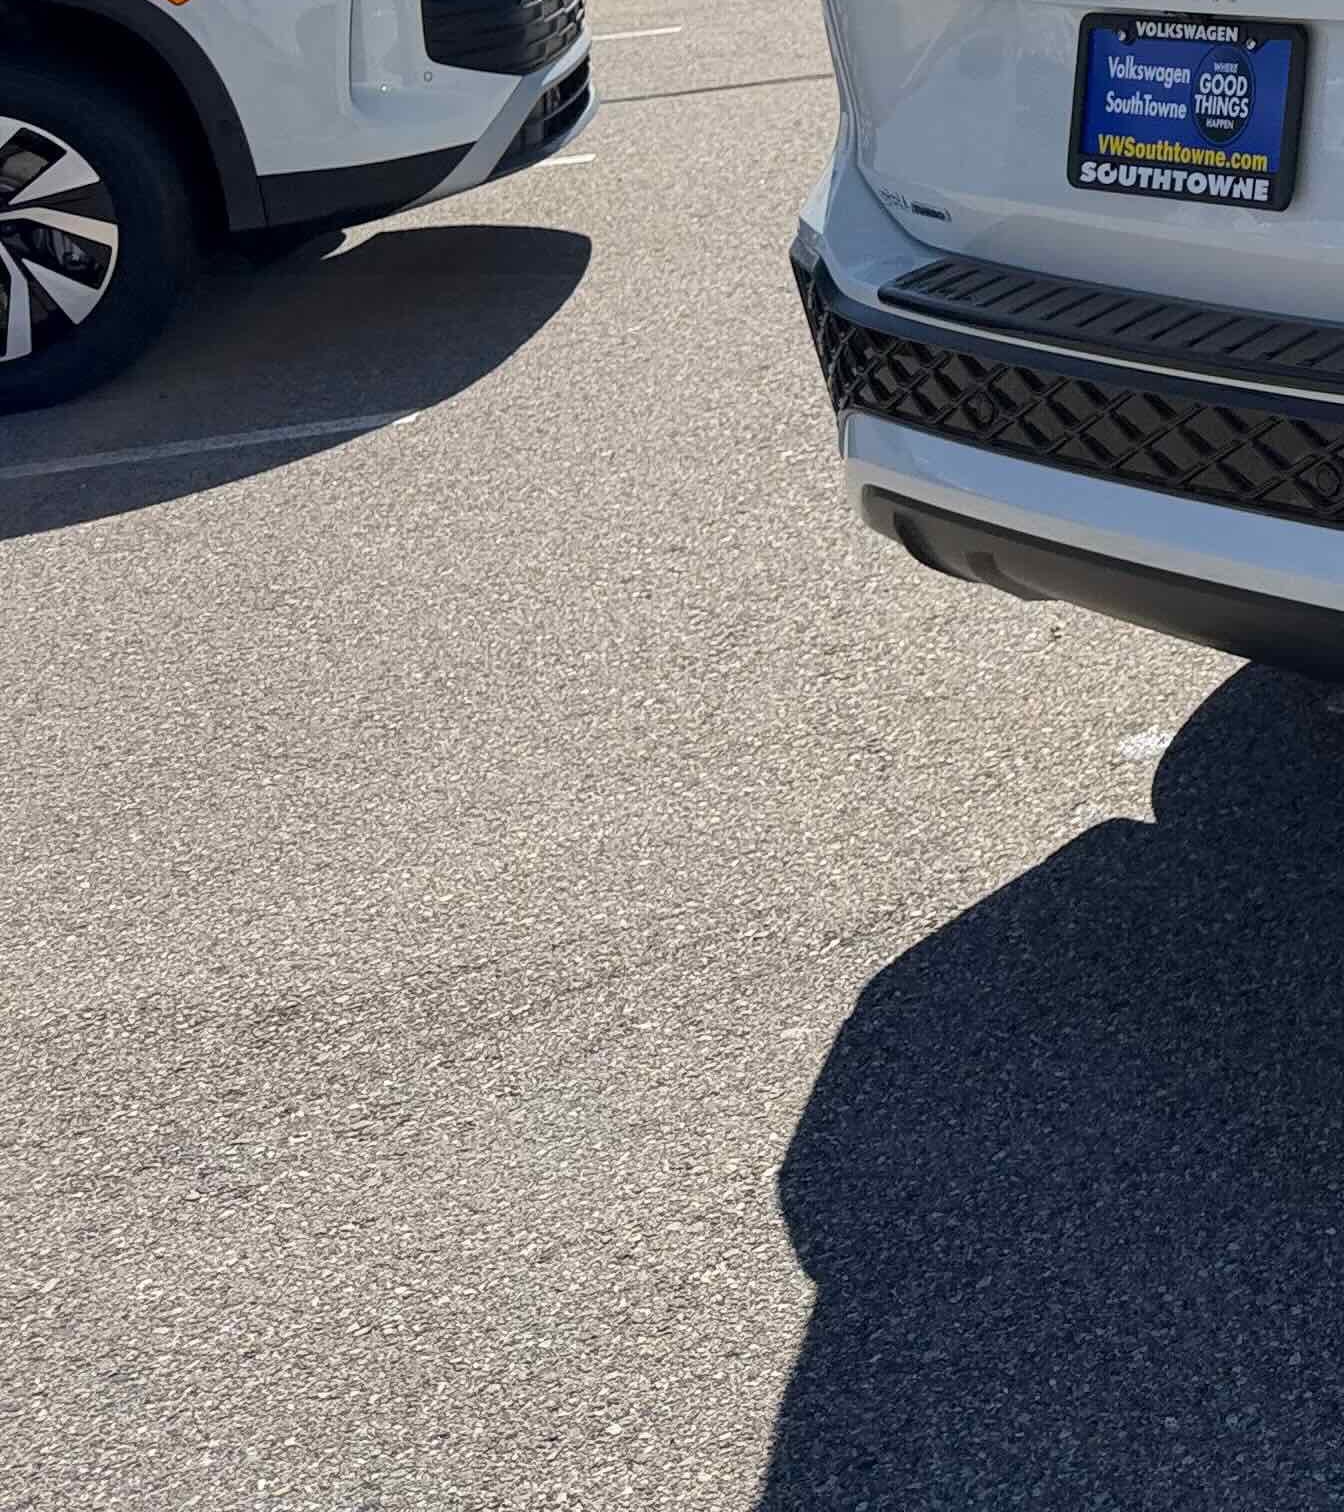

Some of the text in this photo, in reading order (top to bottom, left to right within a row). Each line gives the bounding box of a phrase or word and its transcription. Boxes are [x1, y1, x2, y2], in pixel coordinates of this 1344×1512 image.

[1136, 21, 1239, 42] VOLKSWAGEN
[1108, 56, 1190, 88] Volkswagen
[1199, 73, 1248, 96] GOOD
[1105, 91, 1187, 119] SouthTowne
[1194, 94, 1249, 118] THINGS
[1098, 134, 1268, 171] VWSouthtowne.com
[1080, 161, 1270, 202] SOUTHTOWNE
